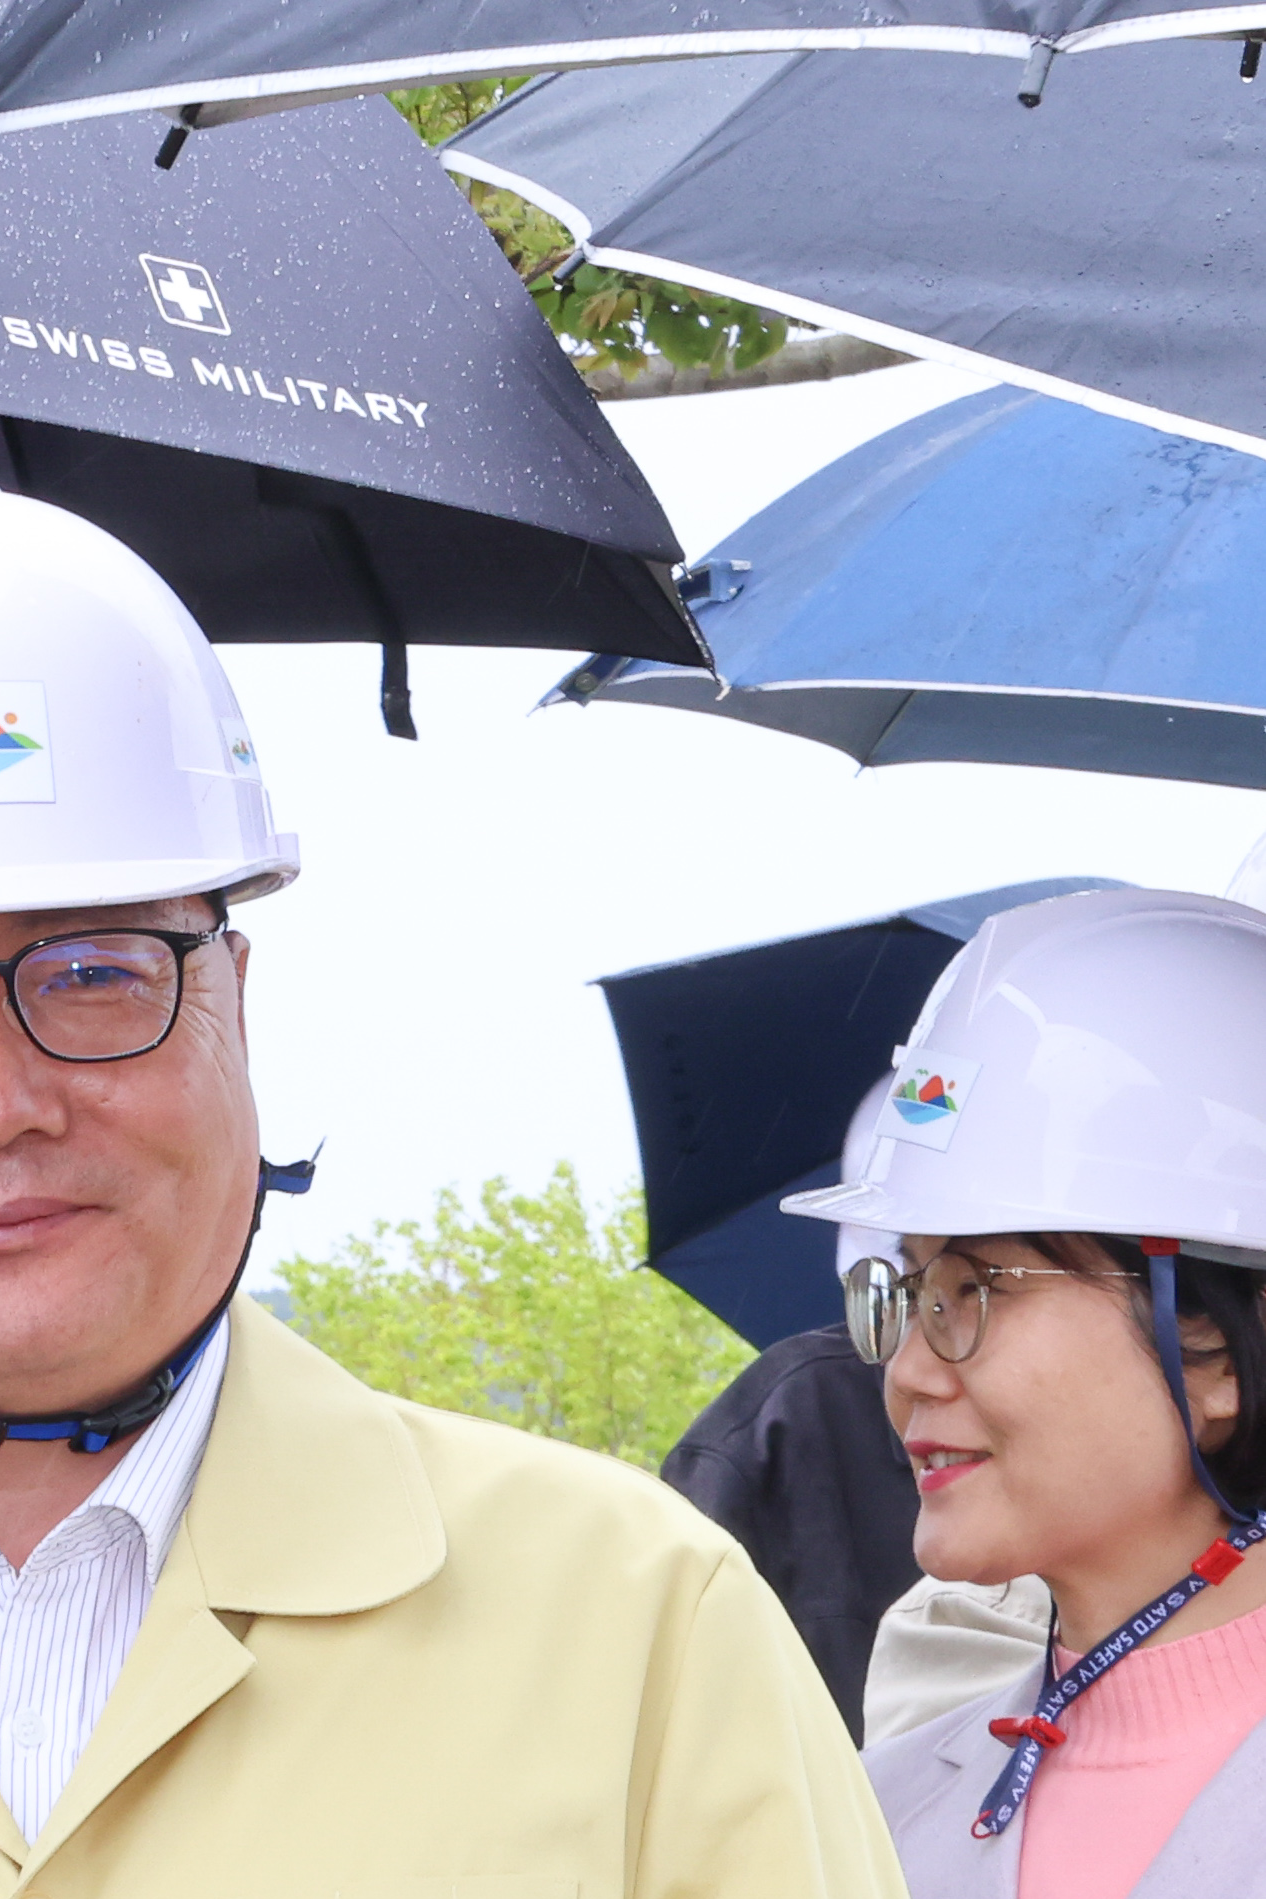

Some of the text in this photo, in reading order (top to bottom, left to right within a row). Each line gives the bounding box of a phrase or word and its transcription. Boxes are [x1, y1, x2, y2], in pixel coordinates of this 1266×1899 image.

[3, 316, 428, 428] SWISS MILITARY
[1132, 1591, 1186, 1636] SATO
[1011, 1738, 1039, 1803] AFETY
